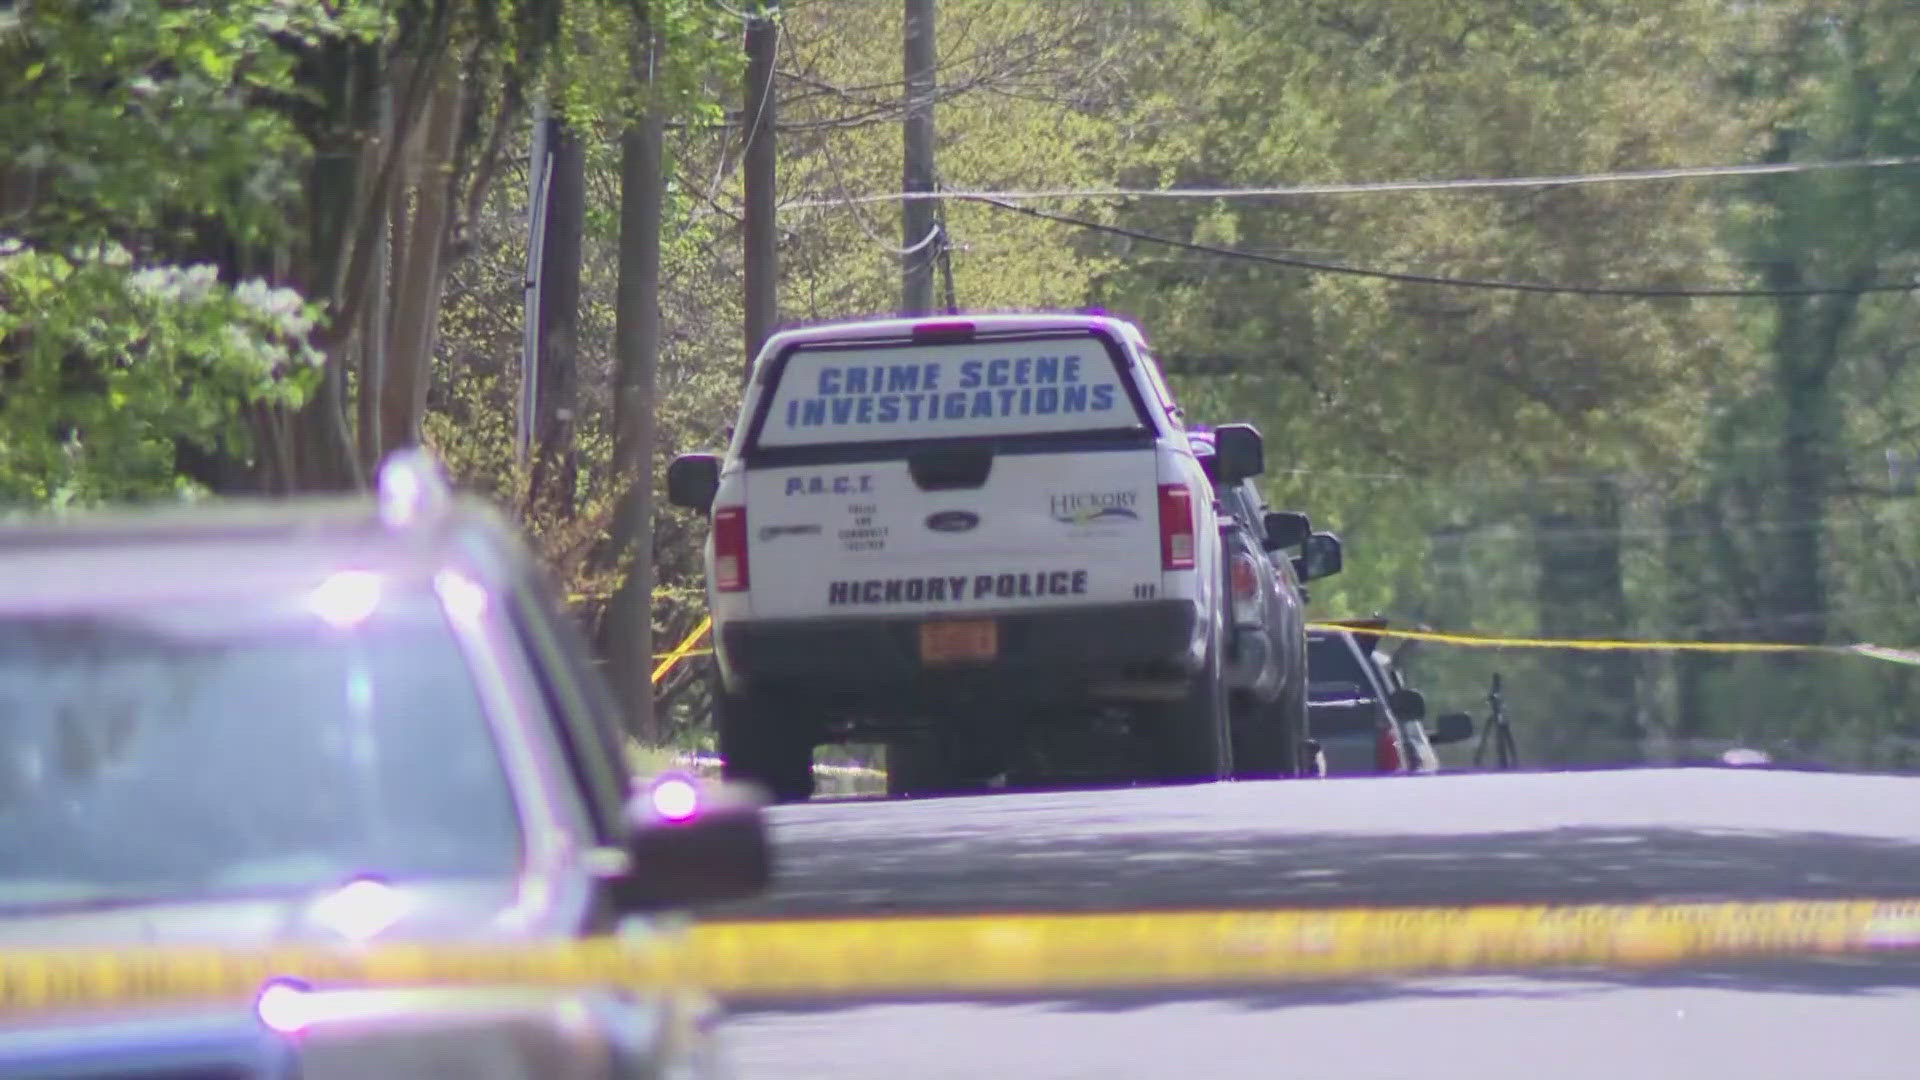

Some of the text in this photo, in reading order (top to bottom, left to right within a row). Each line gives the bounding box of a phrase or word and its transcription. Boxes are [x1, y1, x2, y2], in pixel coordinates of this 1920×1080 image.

[818, 355, 1081, 395] CRIME SCENE
[786, 383, 1115, 428] INVESTIGATIONS
[829, 569, 1088, 605] HICKORY POLICE
